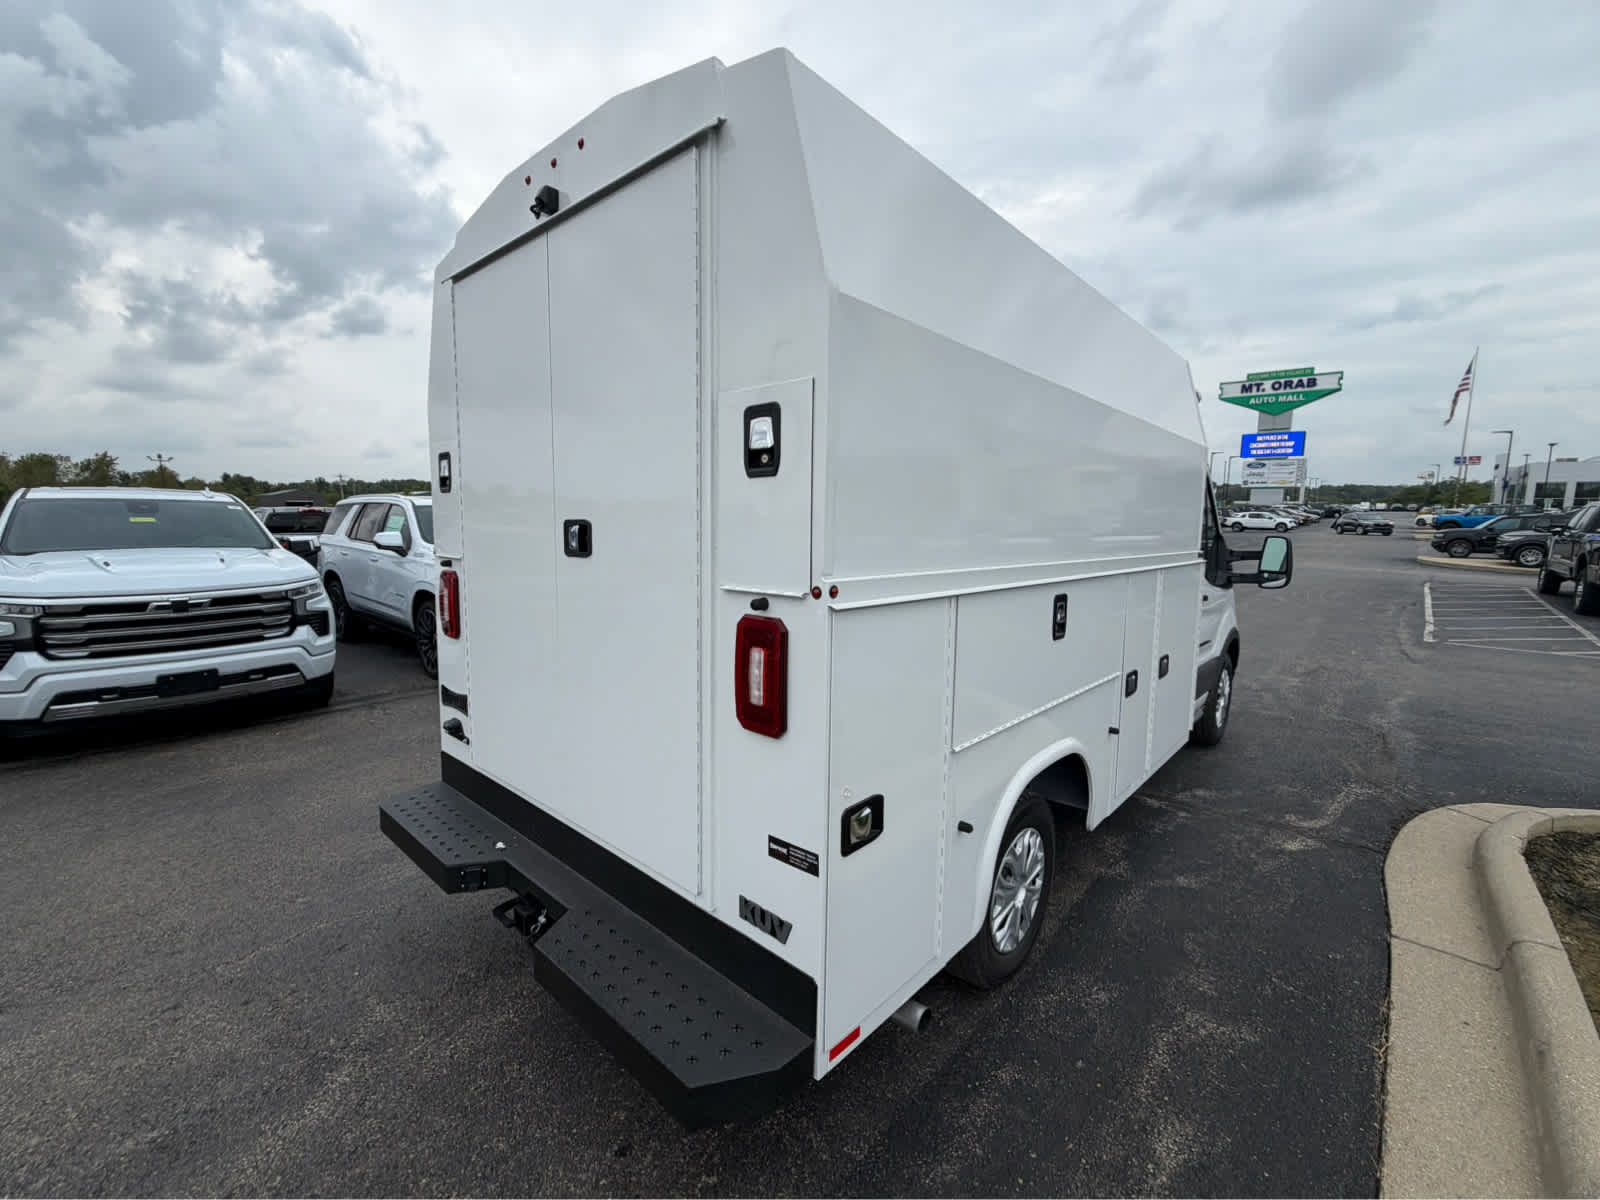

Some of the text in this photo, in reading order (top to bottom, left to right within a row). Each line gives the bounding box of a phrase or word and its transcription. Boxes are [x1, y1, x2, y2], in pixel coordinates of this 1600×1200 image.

[1240, 378, 1318, 394] MT. ORAB
[1249, 393, 1305, 405] AUTO MALL
[739, 894, 793, 945] KUV
